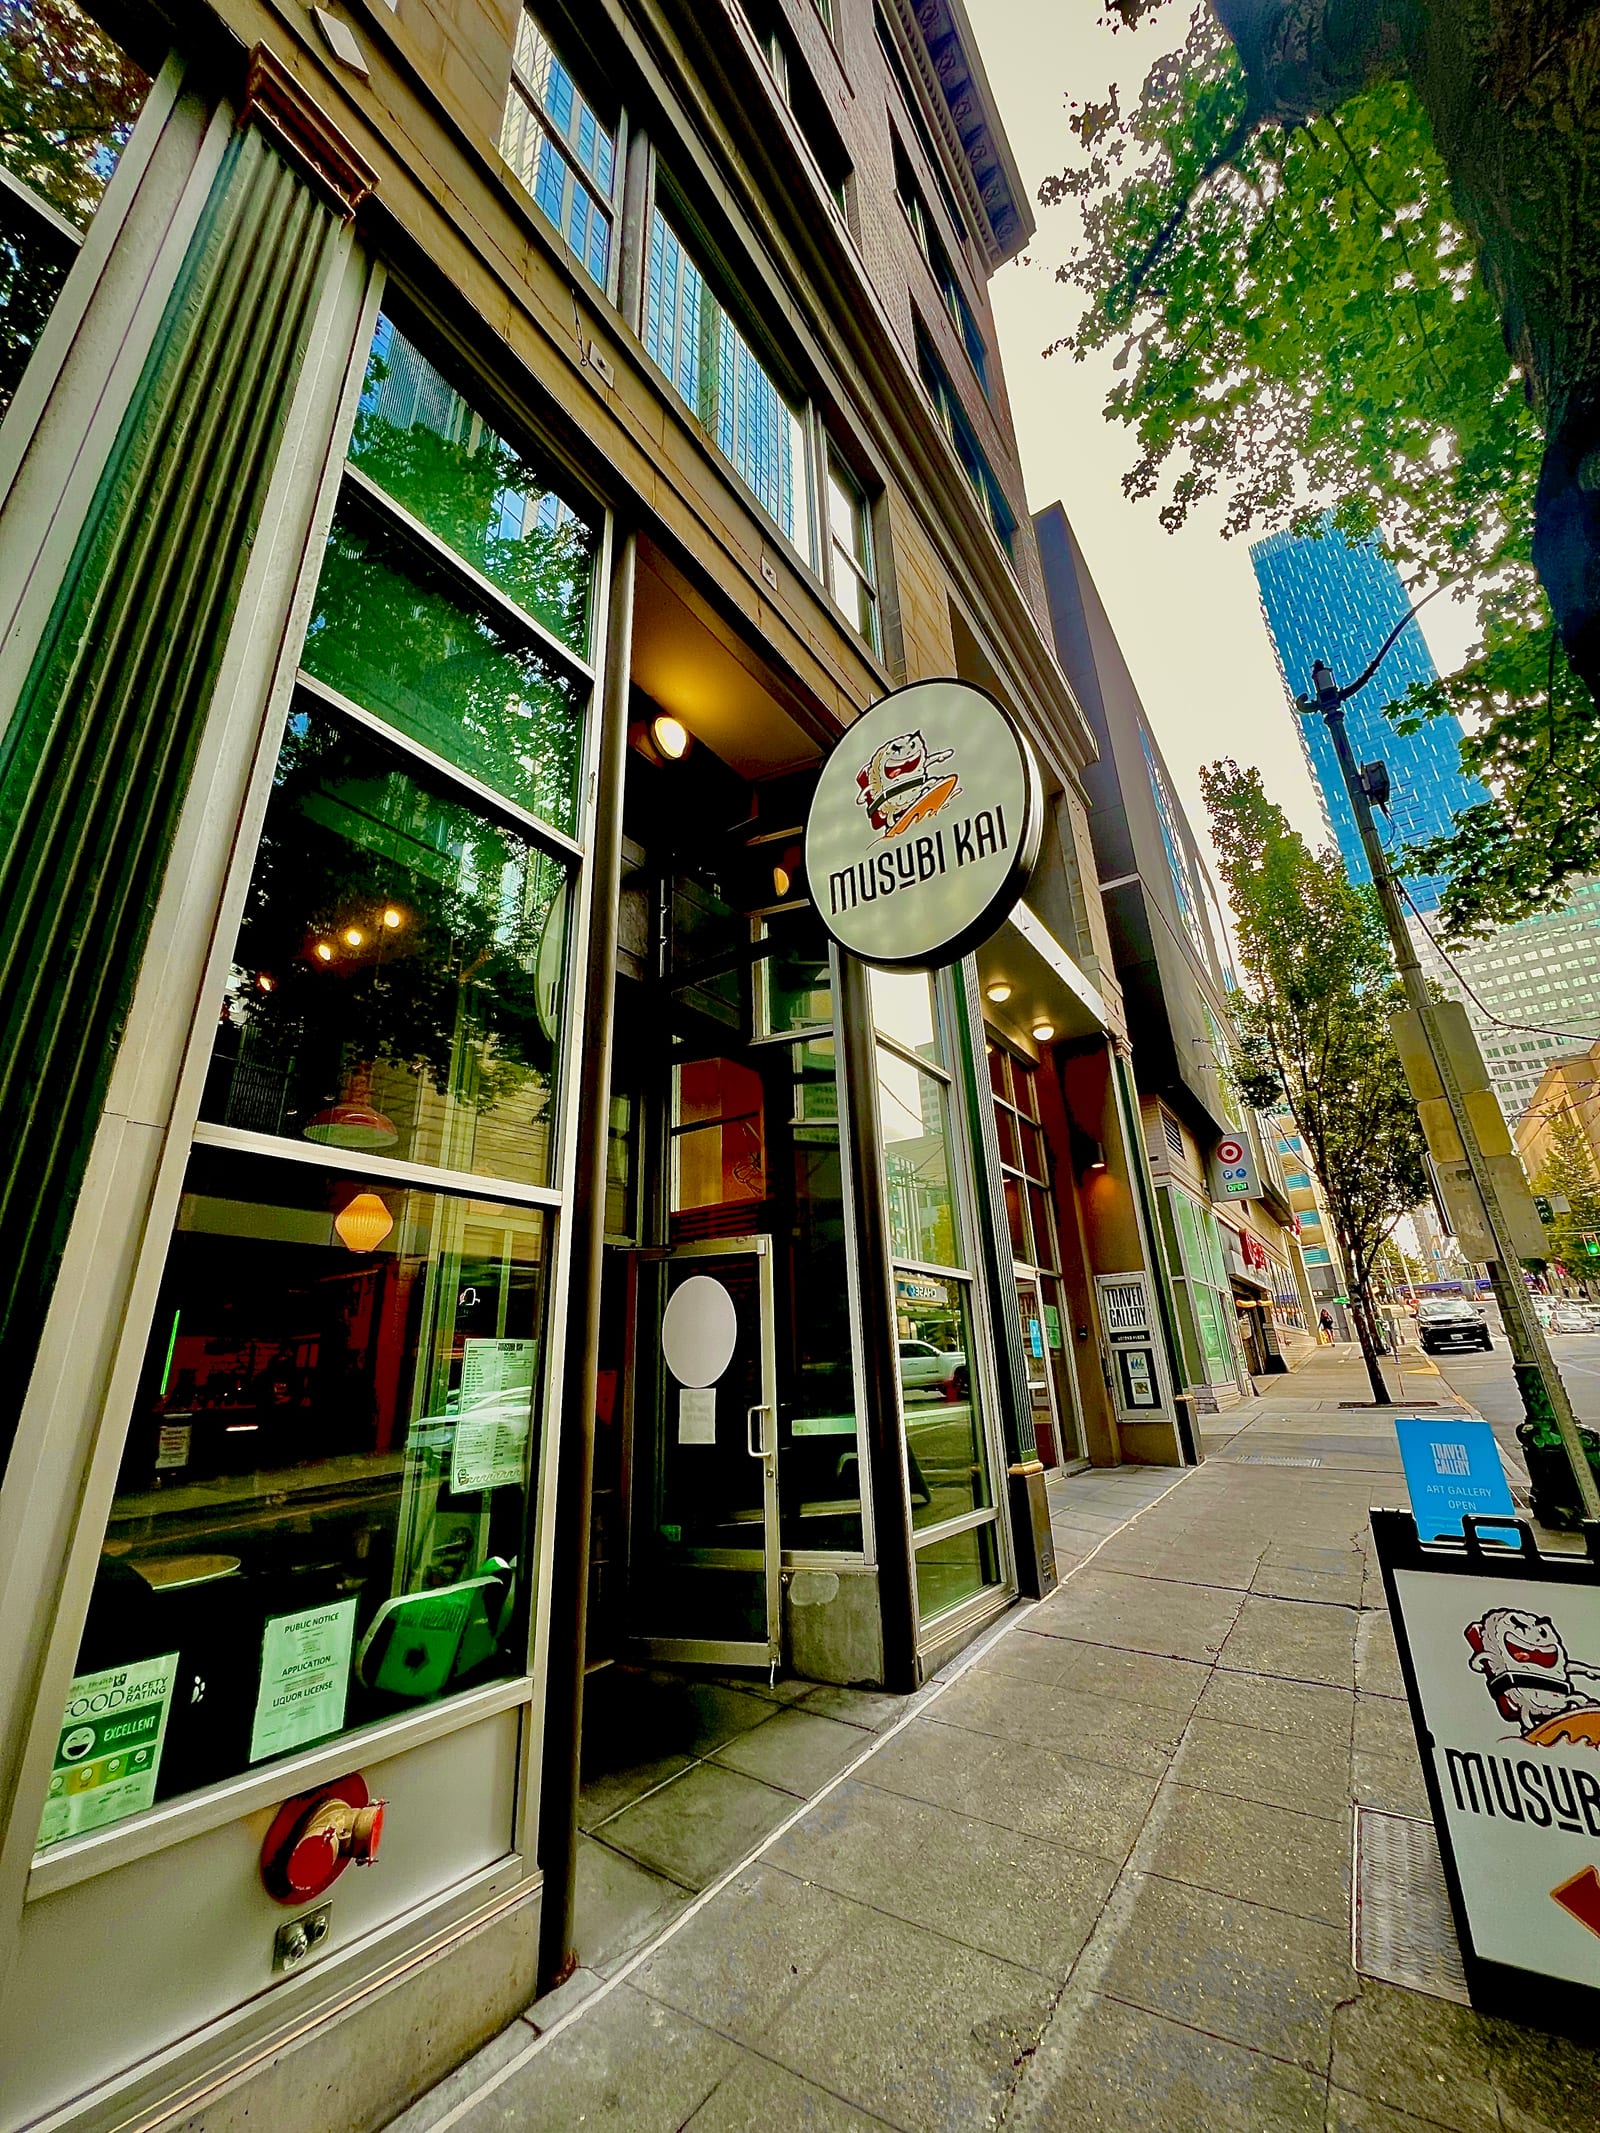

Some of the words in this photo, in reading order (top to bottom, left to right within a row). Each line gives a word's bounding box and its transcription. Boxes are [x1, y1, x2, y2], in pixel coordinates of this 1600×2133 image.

[829, 830, 947, 915] MUSUBI
[953, 805, 1008, 868] KAI
[1227, 1183, 1247, 1191] OPEN
[1105, 1286, 1144, 1308] TRAVER
[1110, 1306, 1146, 1327] GALLERY
[1430, 1443, 1468, 1460] TRAVER
[1434, 1459, 1471, 1476] GALLERY
[1426, 1484, 1444, 1494] ART
[1447, 1486, 1492, 1497] GALLERY
[1448, 1500, 1477, 1511] OPEN
[284, 1620, 311, 1633] PUBLIC
[312, 1612, 339, 1625] NOTICE
[281, 1655, 331, 1676] APPLICATION
[128, 1676, 168, 1694] SAFETY
[273, 1691, 302, 1707] LIQUOR
[304, 1680, 333, 1698] LICENSE
[126, 1686, 166, 1704] RATING
[103, 1716, 156, 1741] EXCELLENT
